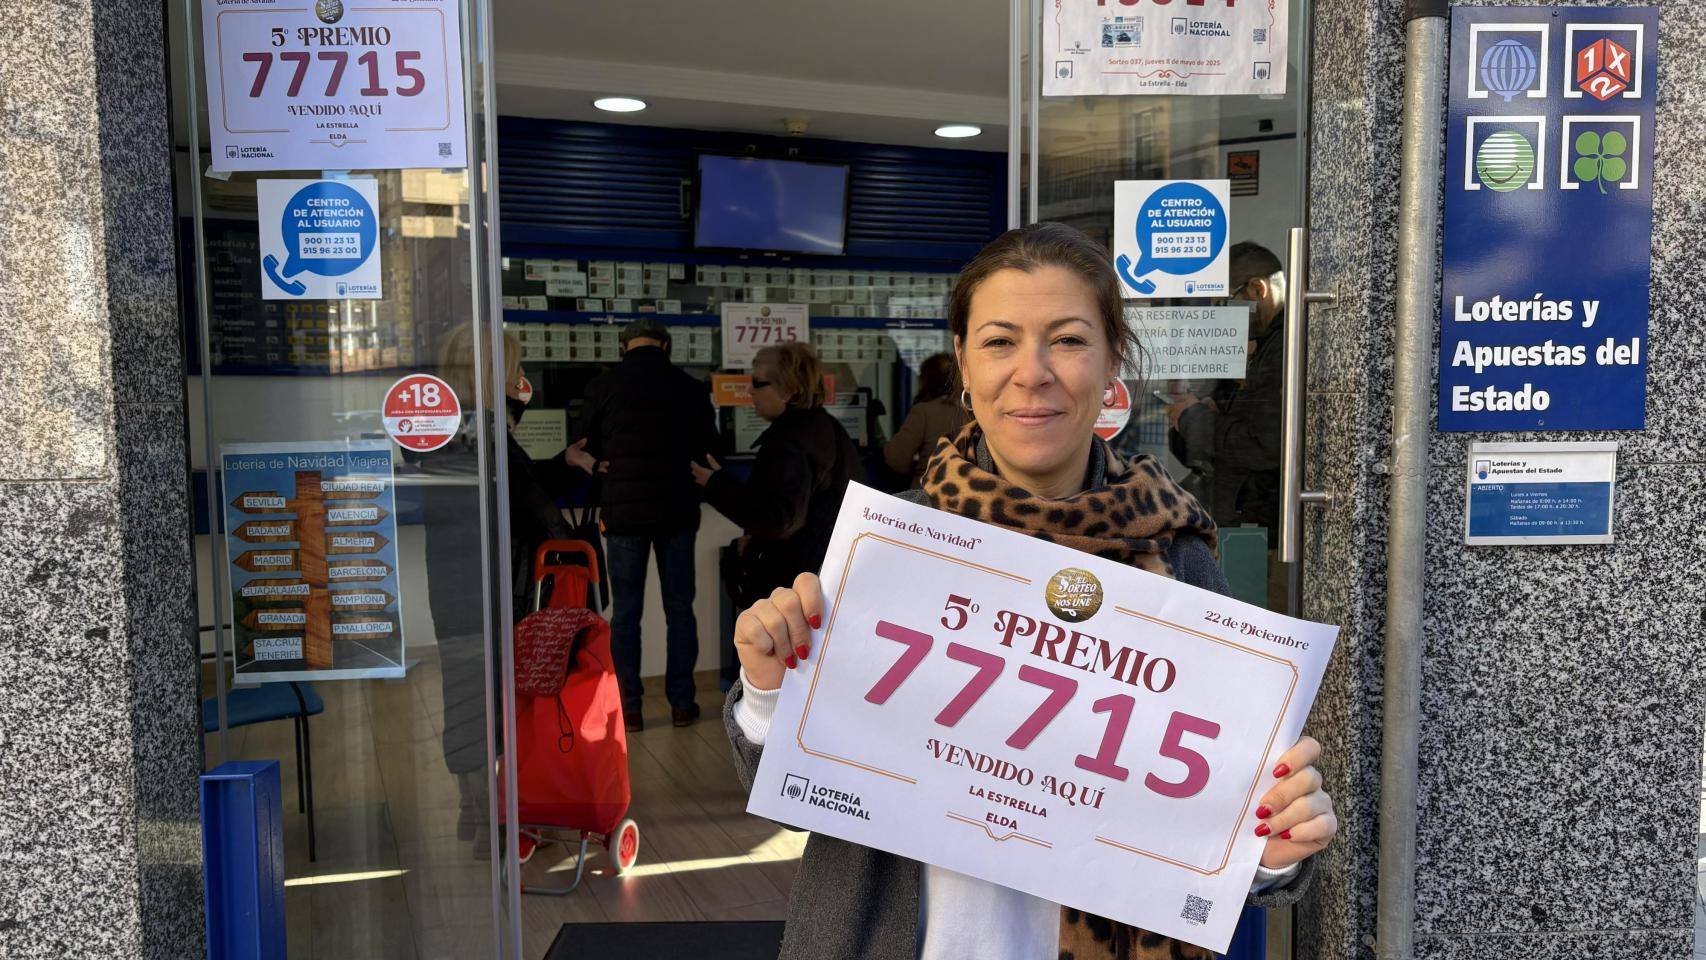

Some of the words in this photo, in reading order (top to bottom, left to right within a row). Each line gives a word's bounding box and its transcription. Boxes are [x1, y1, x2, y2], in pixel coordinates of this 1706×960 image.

[1189, 20, 1222, 29] LOTERÍA
[298, 26, 391, 47] PREMIO
[242, 50, 426, 98] 77715
[288, 105, 345, 116] VENDIDO
[349, 102, 382, 117] AQUÍ
[307, 199, 350, 207] CENTRO
[1161, 198, 1202, 207] CENTRO
[293, 209, 308, 217] DE
[311, 207, 364, 217] ATENCIÓN
[1148, 209, 1162, 217] DE
[1164, 206, 1216, 217] ATENCIÓN
[297, 219, 312, 227] AL
[313, 219, 361, 227] USUARIO
[1151, 219, 1165, 227] AL
[1166, 219, 1212, 227] USUARIO
[1146, 310, 1199, 320] RESERVAS
[1202, 310, 1216, 319] DE
[1454, 293, 1573, 322] Loterías
[1582, 300, 1600, 328] y
[735, 326, 797, 343] 77715
[1171, 328, 1184, 338] DE
[1188, 328, 1237, 337] NAVIDAD
[1210, 346, 1245, 355] HASTA
[1452, 340, 1587, 374] Apuestas
[1595, 337, 1640, 365] del
[1153, 364, 1168, 374] DE
[1170, 364, 1229, 374] DICIEMBRE
[398, 383, 441, 407] +18
[1452, 383, 1550, 412] Estado
[269, 458, 284, 469] de
[287, 456, 344, 468] Navidad
[349, 455, 389, 468] Viajera
[321, 482, 358, 491] CIUDAD
[361, 482, 384, 491] REAL
[246, 498, 283, 506] SEVILLA
[329, 510, 376, 519] VALENCIA
[248, 526, 288, 535] BADAJOZ
[908, 523, 924, 535] de
[925, 527, 982, 550] Navidad
[255, 556, 291, 565] MADRID
[330, 567, 386, 576] BARCELONA
[242, 585, 309, 595] GUADALAJARA
[334, 595, 385, 604] PAMPLONA
[1055, 599, 1071, 607] NOS
[1072, 598, 1092, 607] UNE
[259, 614, 305, 623] GRANADA
[334, 624, 391, 633] P.MALLORCA
[1204, 610, 1221, 624] 22
[1222, 617, 1238, 629] de
[1240, 622, 1310, 650] Diciembre
[940, 593, 981, 631] 5º
[993, 610, 1177, 693] PREMIO
[256, 650, 299, 659] TENERIFE
[863, 619, 1221, 800] 77715
[926, 738, 1034, 786] VENDIDO
[1041, 775, 1107, 810] AQUÍ
[811, 784, 861, 807] LOTERÍA
[968, 785, 985, 799] LA
[987, 790, 1047, 818] ESTRELLA
[808, 795, 871, 821] NACIONAL
[985, 812, 1018, 830] ELDA
